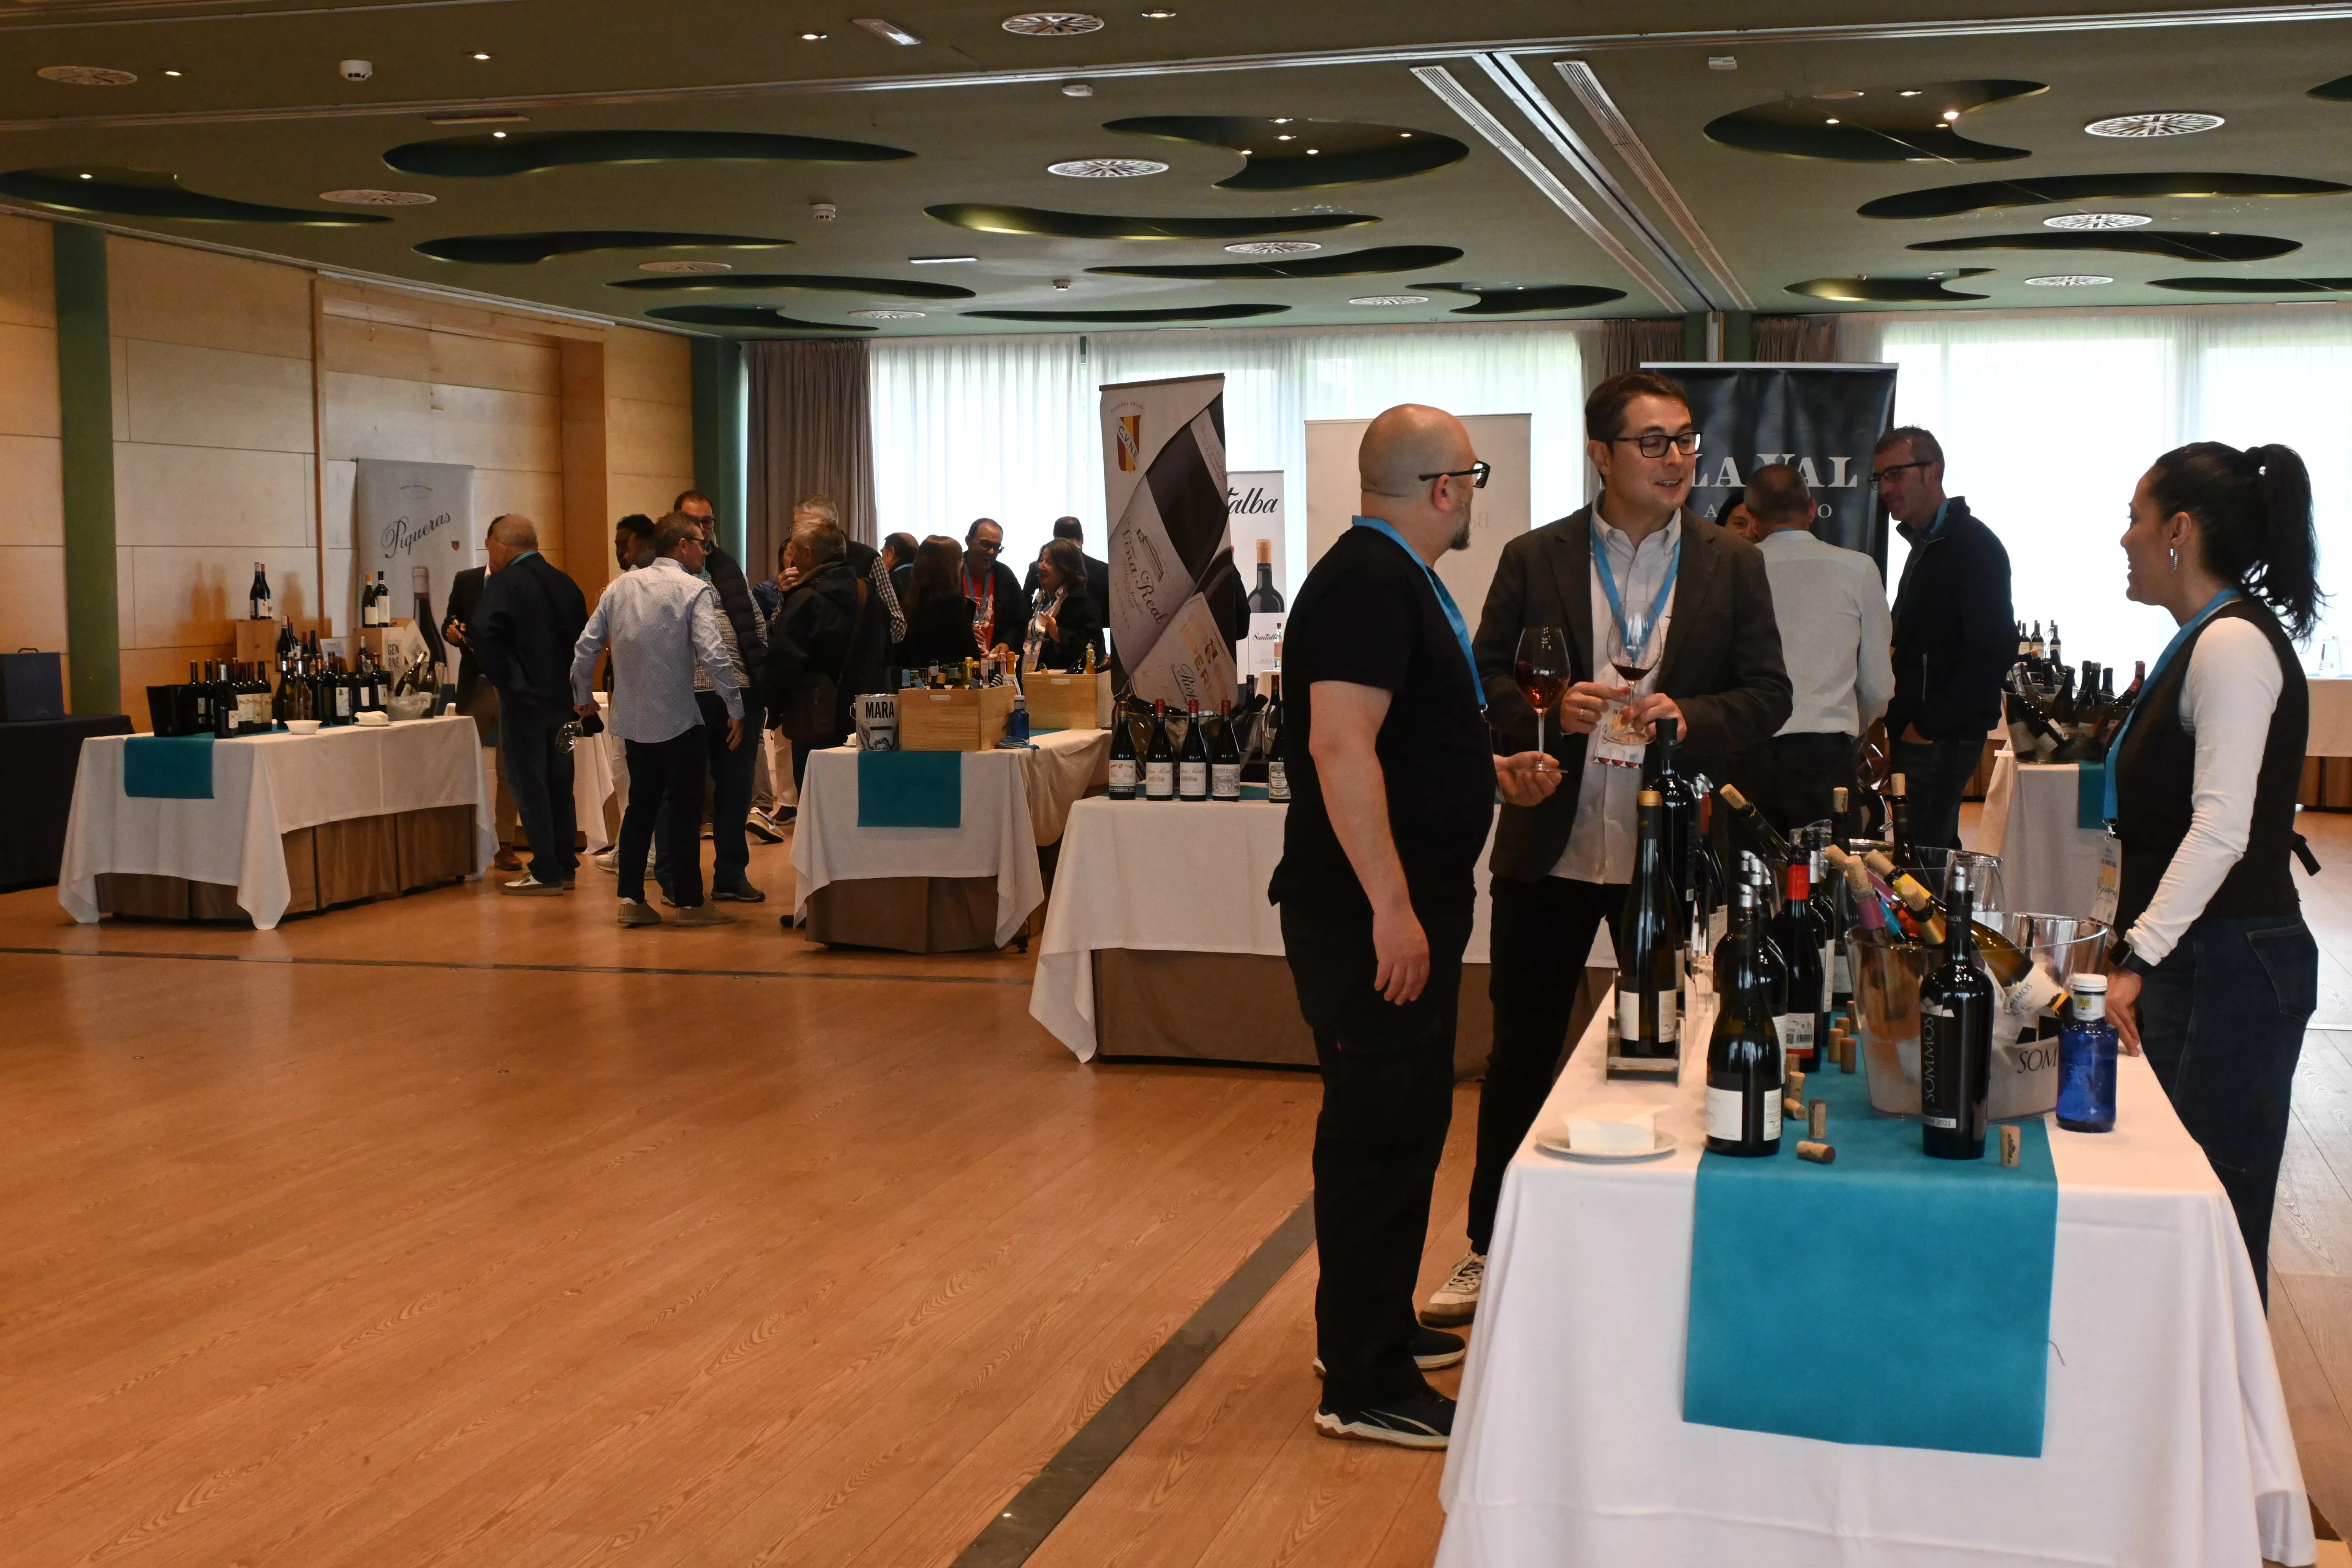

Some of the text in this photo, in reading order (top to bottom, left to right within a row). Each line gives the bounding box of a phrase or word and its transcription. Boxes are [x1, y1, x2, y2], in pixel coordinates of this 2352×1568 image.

[381, 512, 450, 558] Piqueras
[1136, 571, 1168, 624] Real
[388, 644, 399, 655] GEN
[388, 657, 400, 668] ONE
[865, 701, 895, 719] MARA
[1923, 1016, 1935, 1102] SOMMOS
